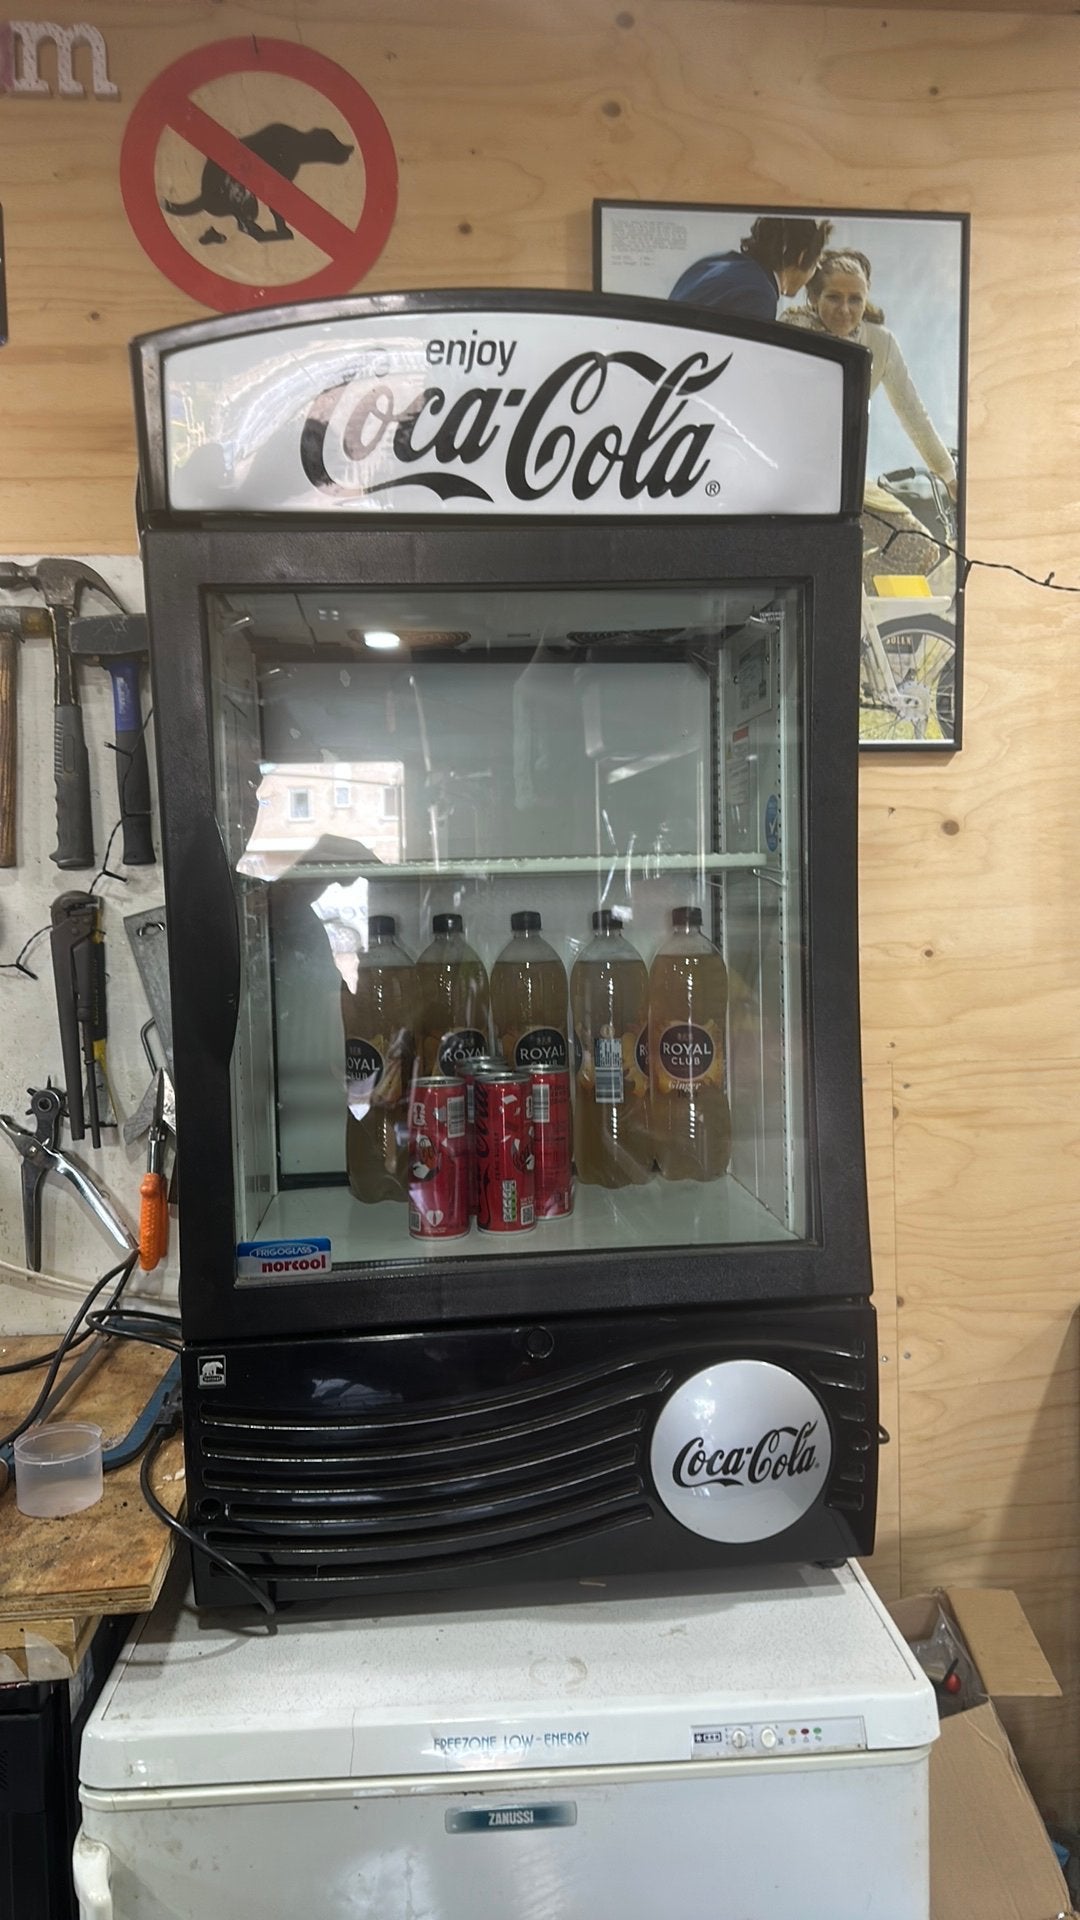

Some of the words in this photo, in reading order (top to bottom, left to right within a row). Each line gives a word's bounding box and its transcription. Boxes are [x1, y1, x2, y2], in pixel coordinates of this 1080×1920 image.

[426, 329, 518, 377] enjoy
[299, 351, 735, 503] Coca-Cola
[519, 1044, 565, 1060] ROYAL
[663, 1042, 712, 1056] ROYAL
[346, 1056, 381, 1072] OYAL
[670, 1057, 701, 1066] CLUB
[256, 1246, 312, 1257] FRIGOGLASS
[261, 1254, 326, 1274] norcool
[672, 1419, 818, 1488] Coca-Cola
[488, 1809, 534, 1826] ZANUSSI
